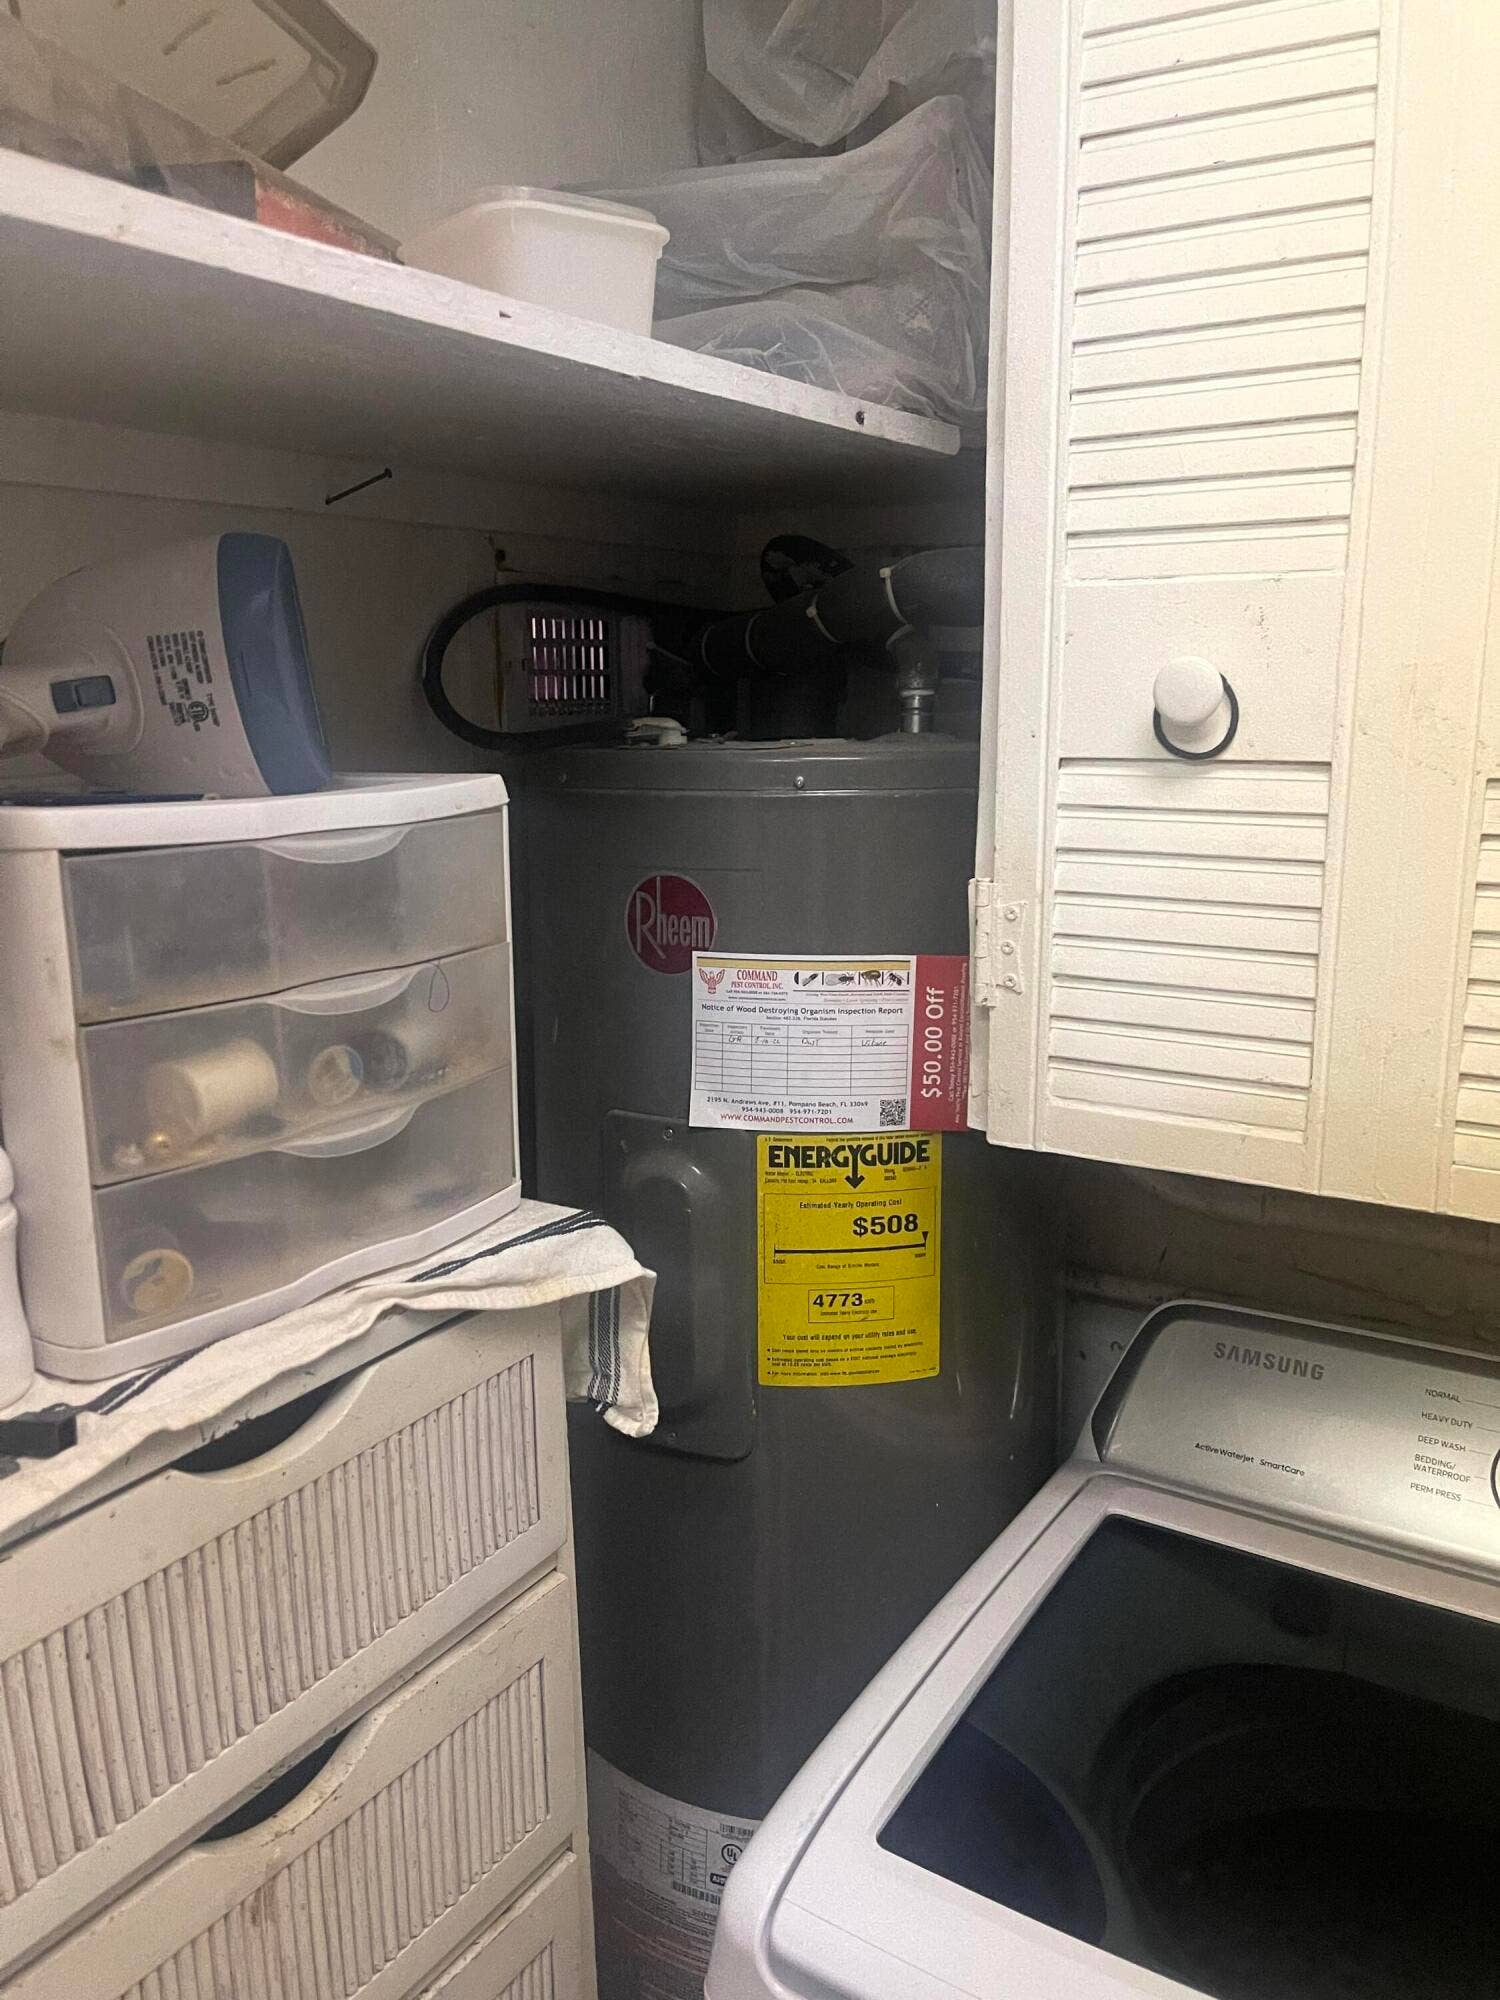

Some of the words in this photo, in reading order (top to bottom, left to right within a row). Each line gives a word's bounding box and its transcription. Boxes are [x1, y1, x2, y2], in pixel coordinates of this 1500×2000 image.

[635, 876, 710, 960] Rheem
[736, 969, 778, 982] COMMAND
[701, 1003, 725, 1012] Notice
[726, 1004, 734, 1012] of
[736, 1005, 757, 1013] Wood
[758, 1006, 798, 1015] Destroying
[800, 1007, 836, 1016] Organism
[878, 1007, 903, 1015] Report
[925, 986, 945, 1019] Off
[920, 1026, 943, 1098] $50.00
[720, 1113, 854, 1124] WWW.COMMANDPESTCONTROL.COM
[768, 1139, 930, 1169] ENERGYGUIDE
[800, 1201, 832, 1209] Estimated
[833, 1201, 854, 1209] Yearly
[855, 1200, 887, 1209] Operating
[852, 1213, 919, 1238] $508
[812, 1292, 863, 1308] 4773
[1213, 1341, 1326, 1381] SAMSUNG
[1425, 1388, 1461, 1403] NORMAL
[1421, 1410, 1450, 1424] HEAVY
[1450, 1417, 1474, 1429] DUTY
[1417, 1434, 1440, 1445] DEEP
[1441, 1440, 1466, 1452] WASH
[1259, 1458, 1305, 1477] SmartCare
[1414, 1453, 1457, 1471] BEDDING/
[1413, 1463, 1471, 1483] WATERPROOF
[1410, 1482, 1434, 1494] PERM
[1435, 1488, 1462, 1502] PRESS
